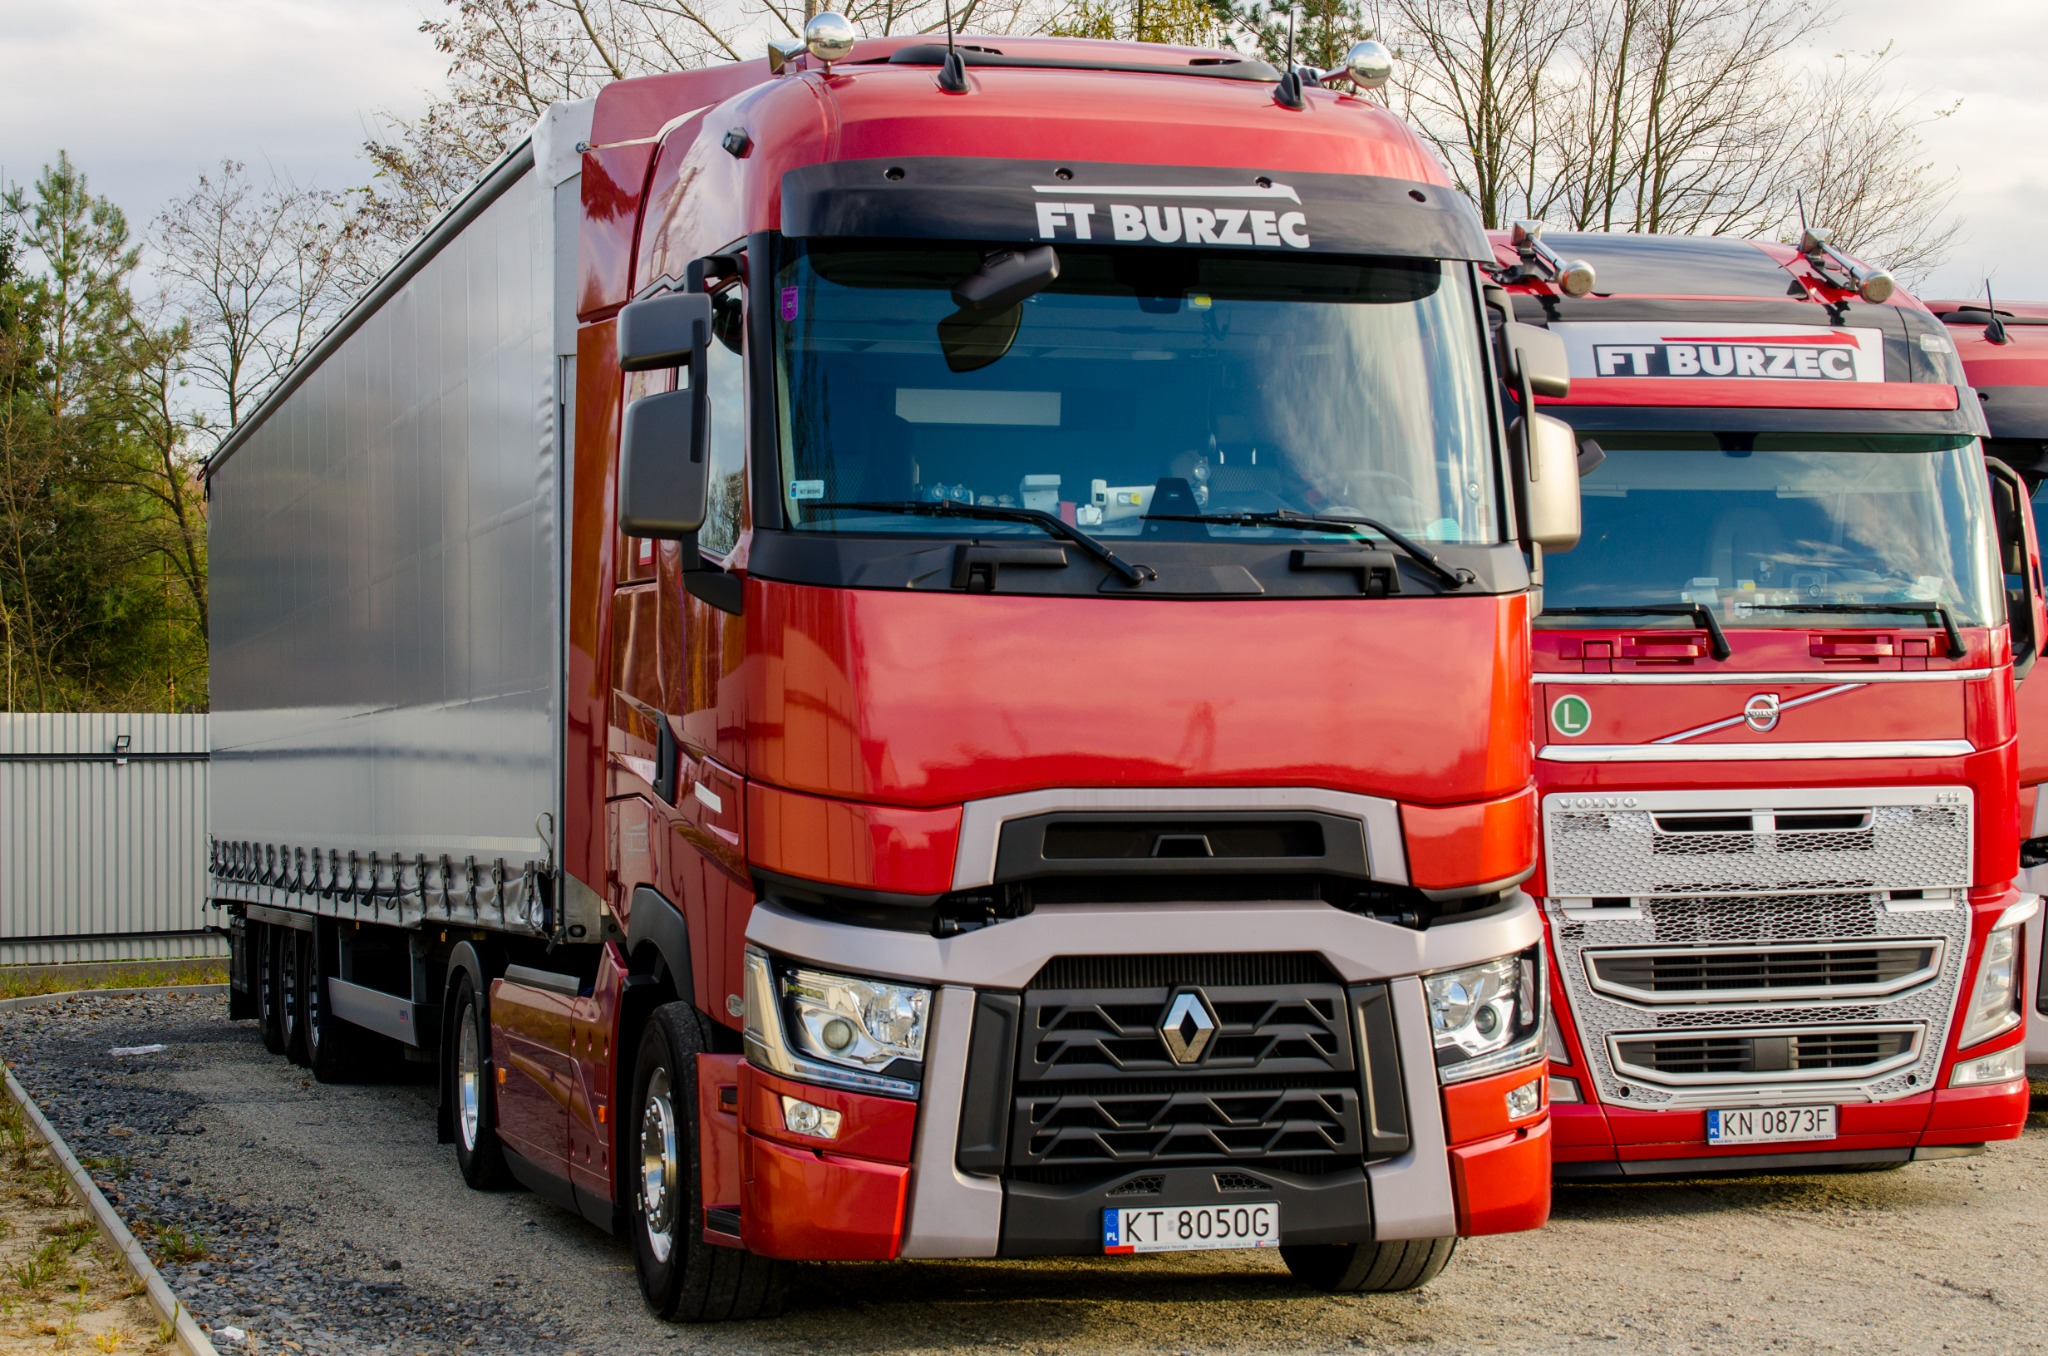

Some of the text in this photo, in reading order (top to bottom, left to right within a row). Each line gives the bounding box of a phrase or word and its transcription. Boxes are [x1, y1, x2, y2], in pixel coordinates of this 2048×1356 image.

[1035, 202, 1311, 249] FT BURZEC
[1596, 345, 1853, 380] FT BURZEC
[1564, 703, 1581, 729] L
[1748, 710, 1778, 718] VOLVO
[1557, 796, 1638, 809] VOLVO
[1936, 792, 1960, 803] FH
[1724, 1108, 1830, 1136] KN 0873F
[1710, 1128, 1719, 1136] PL
[1126, 1207, 1270, 1242] KT 8050G
[1106, 1232, 1118, 1242] PL
